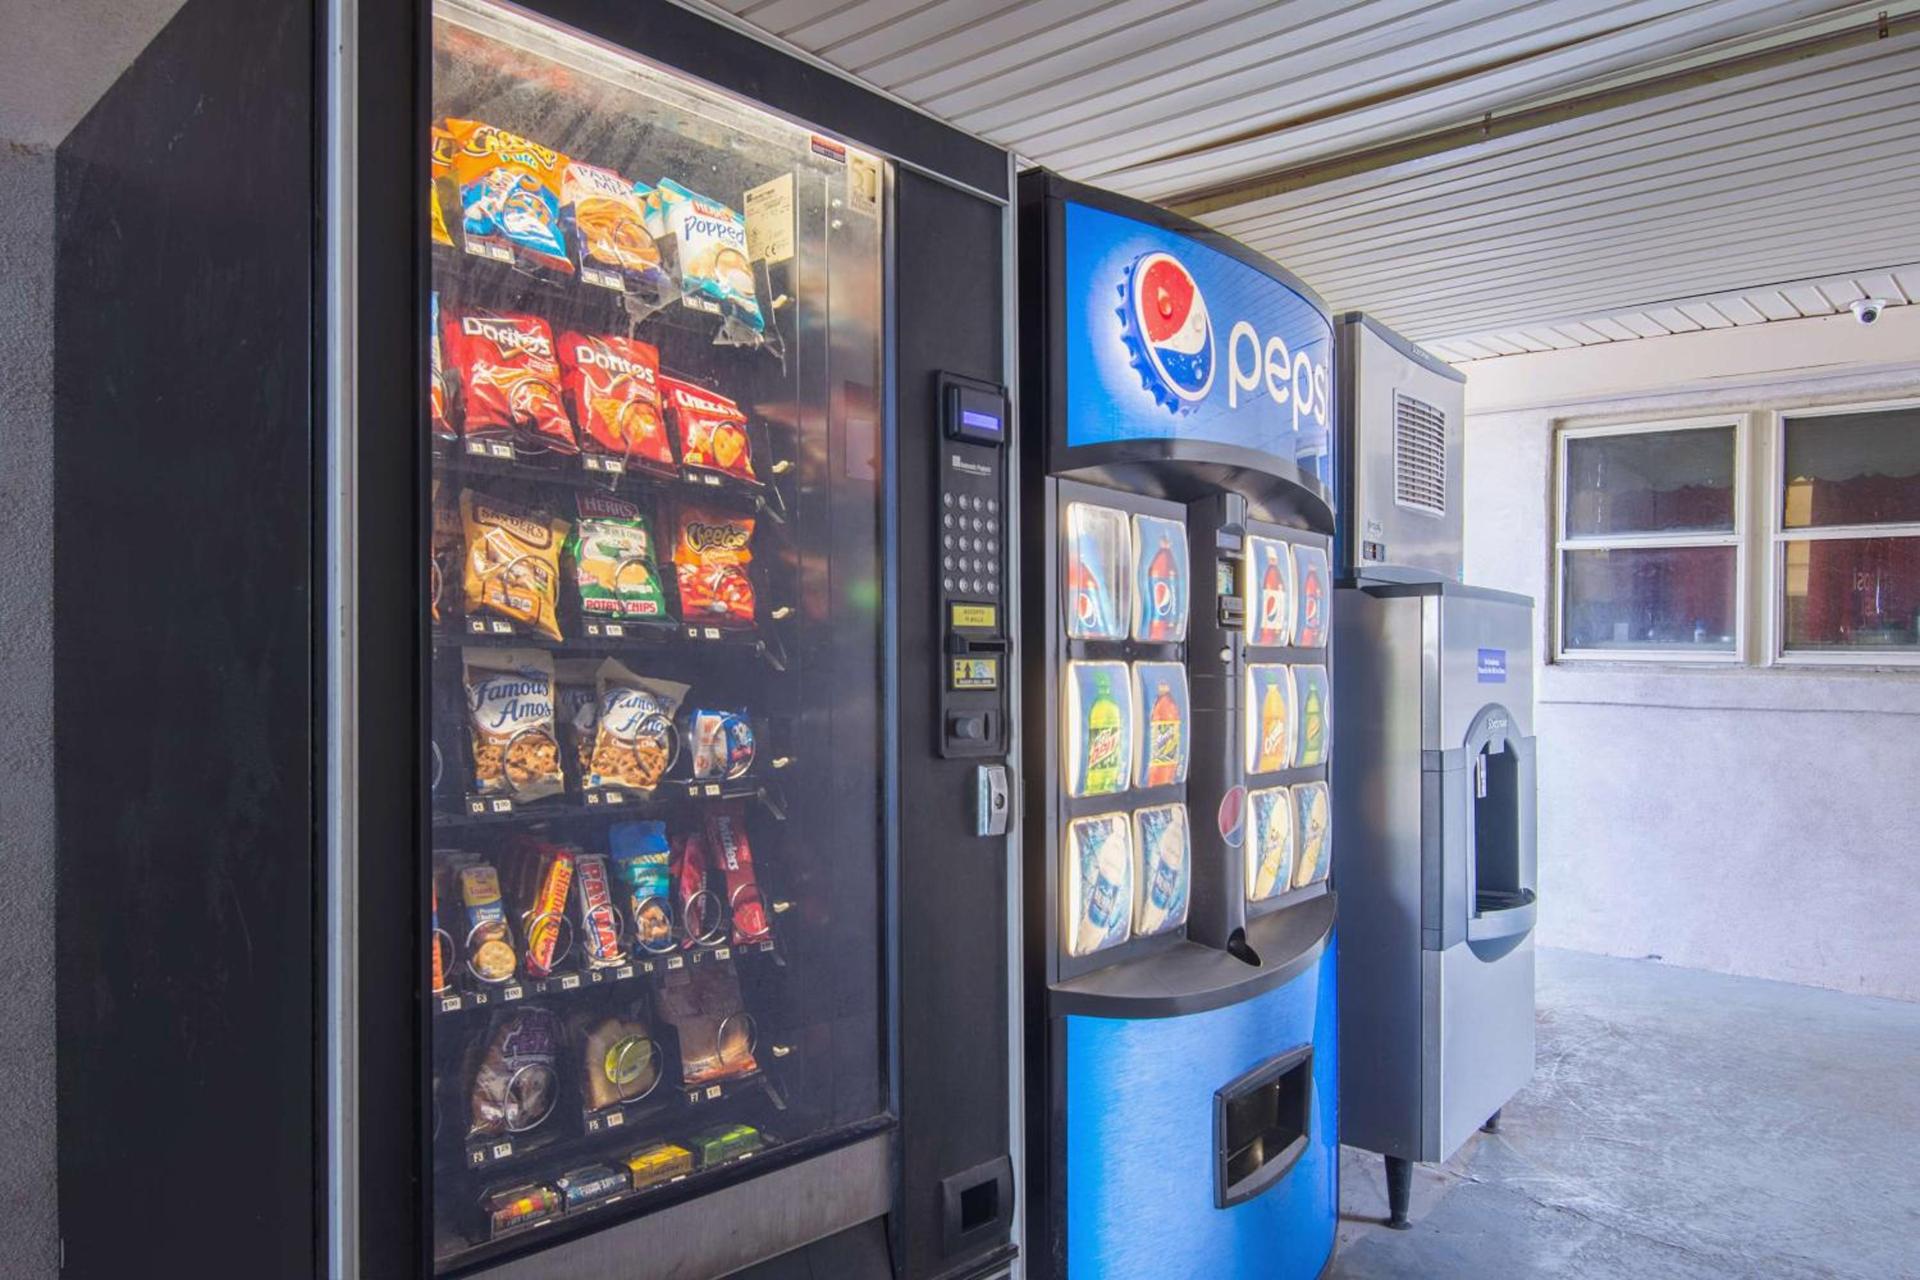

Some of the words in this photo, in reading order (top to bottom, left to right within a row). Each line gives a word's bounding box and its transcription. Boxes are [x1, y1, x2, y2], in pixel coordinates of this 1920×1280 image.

[684, 215, 745, 247] Popped
[463, 317, 552, 356] Doritos
[576, 345, 656, 385] Doritos
[472, 679, 549, 713] Famous
[490, 698, 556, 728] Amos
[580, 863, 617, 958] PAYDAY
